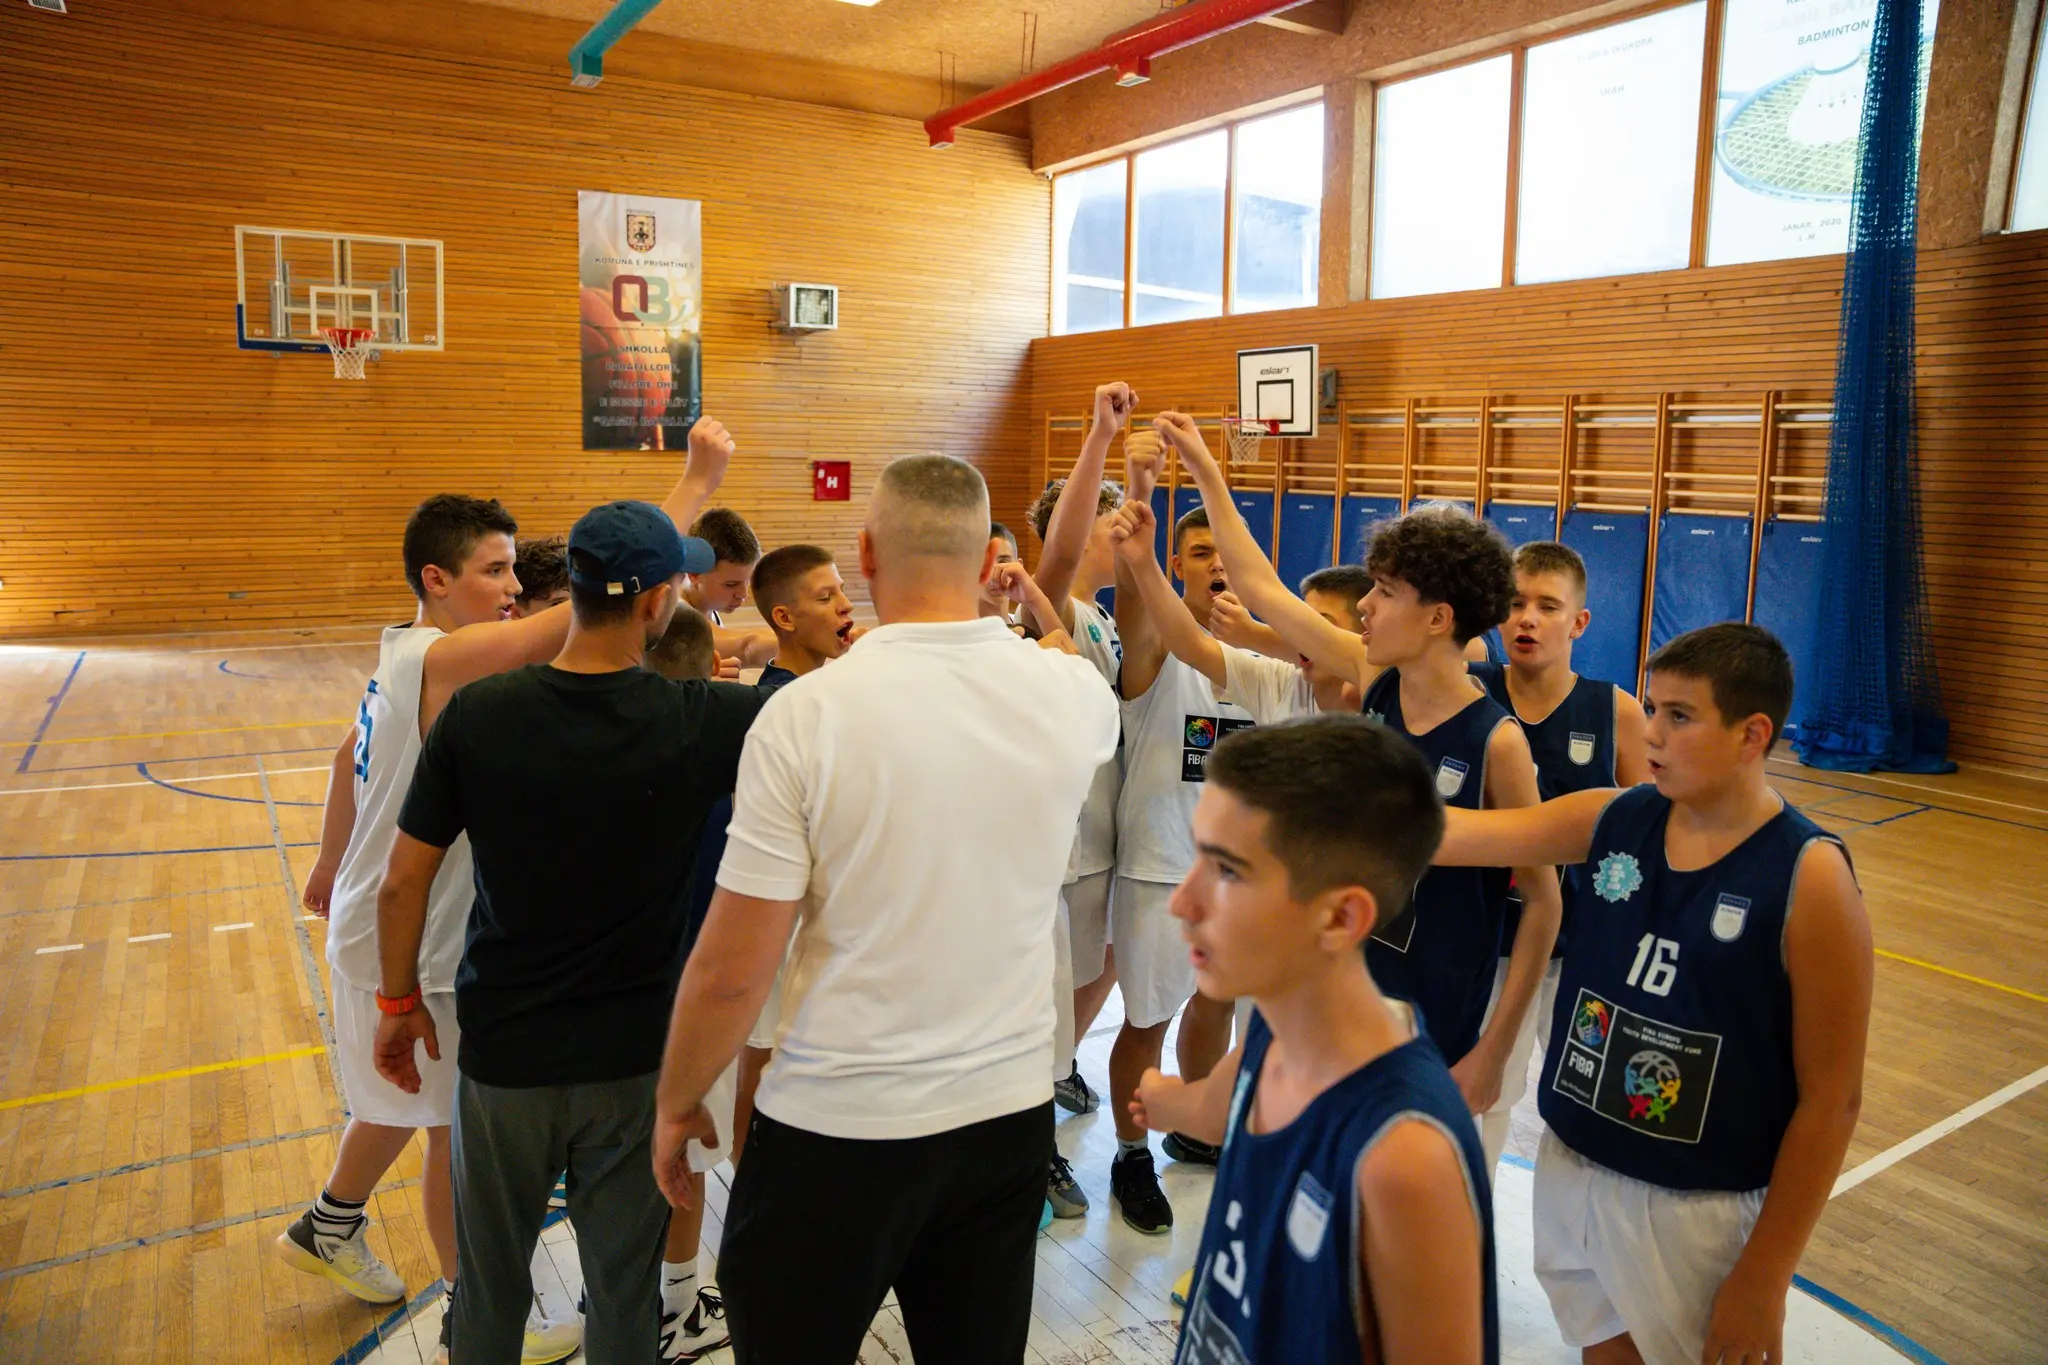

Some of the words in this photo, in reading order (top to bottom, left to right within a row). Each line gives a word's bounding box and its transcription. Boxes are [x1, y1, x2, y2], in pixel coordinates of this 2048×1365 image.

[1797, 19, 1871, 46] BADMINTON
[1819, 217, 1842, 228] 2020
[595, 257, 633, 266] KOMUNA
[618, 346, 668, 354] SHKOLLA
[1260, 366, 1290, 376] elan
[827, 475, 839, 489] H
[1625, 931, 1681, 996] 16
[1641, 1033, 1683, 1051] DEVELOPMENT
[1568, 1051, 1595, 1079] FIBA
